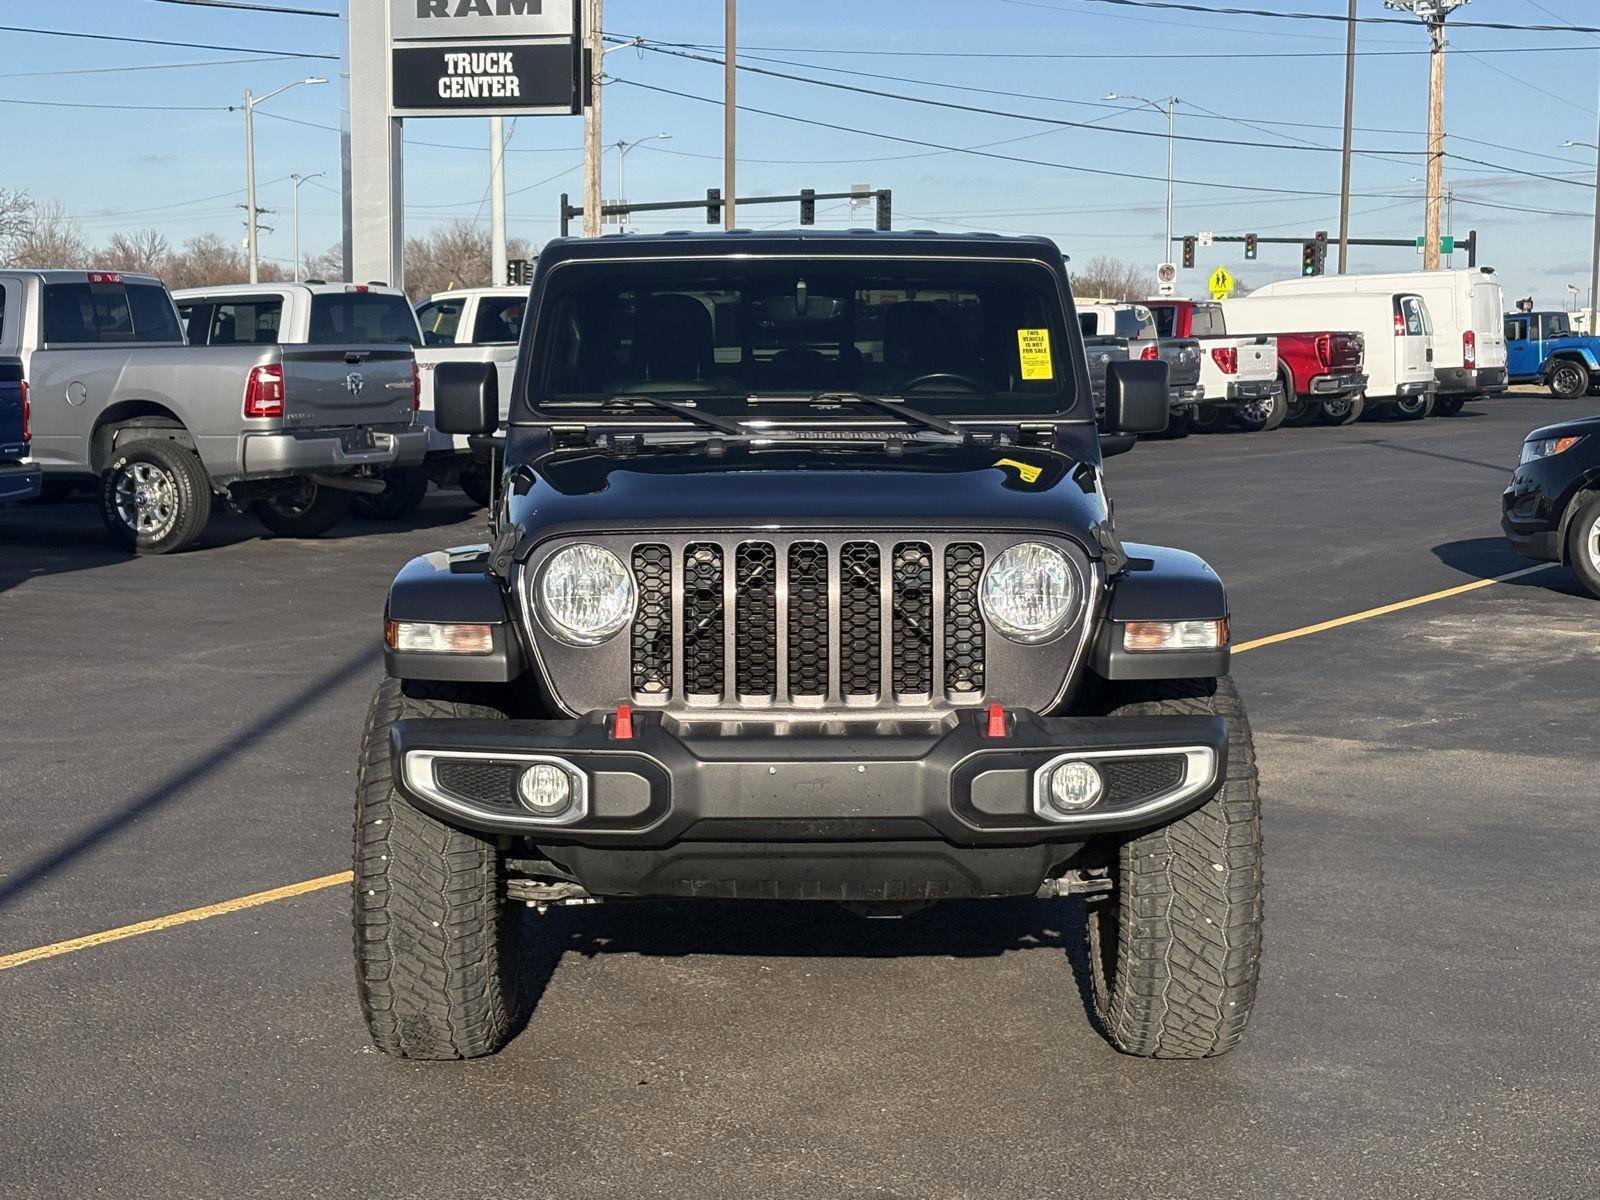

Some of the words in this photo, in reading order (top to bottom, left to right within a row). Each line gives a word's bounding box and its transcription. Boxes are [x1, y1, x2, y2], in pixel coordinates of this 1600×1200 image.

[416, 0, 542, 18] RAM
[444, 52, 514, 75] TRUCK
[438, 75, 520, 99] CENTER
